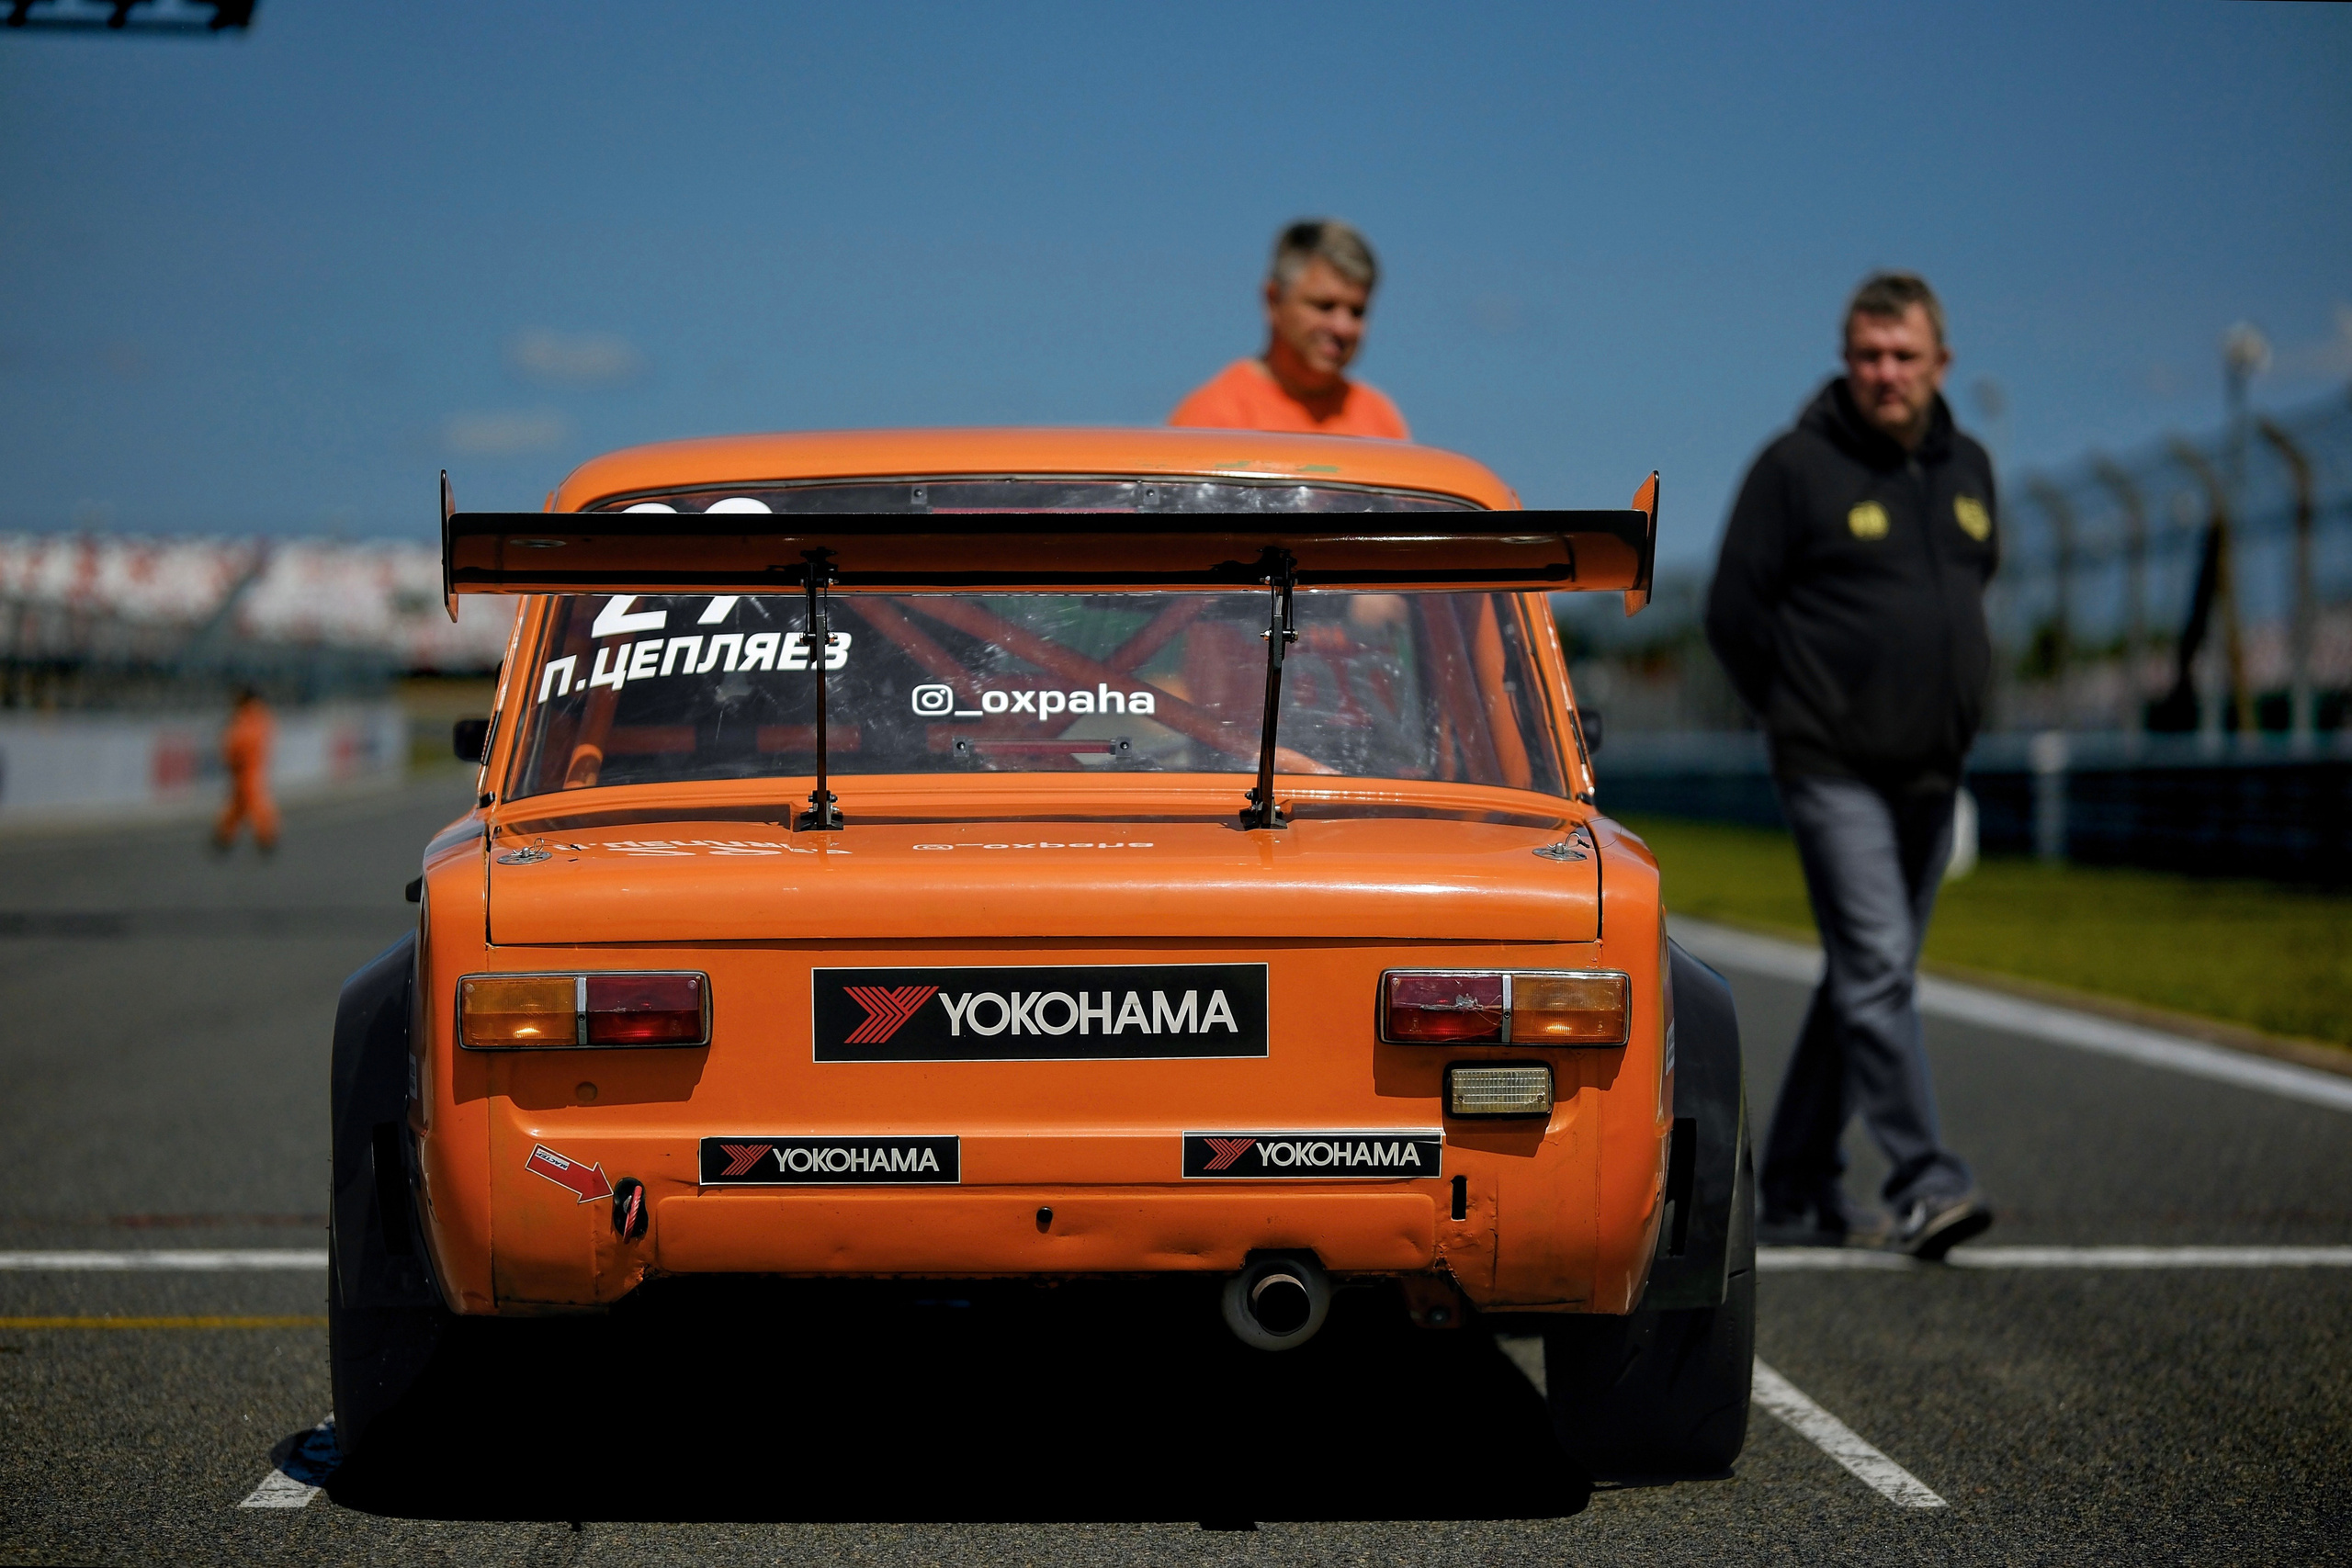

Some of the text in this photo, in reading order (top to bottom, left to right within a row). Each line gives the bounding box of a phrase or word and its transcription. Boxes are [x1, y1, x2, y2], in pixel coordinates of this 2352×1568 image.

[954, 683, 1155, 721] _oxpaha
[938, 989, 1238, 1036] YOKOHAMA
[773, 1147, 940, 1172] YOKOHAMA
[1256, 1142, 1421, 1167] YOKOHAMA
